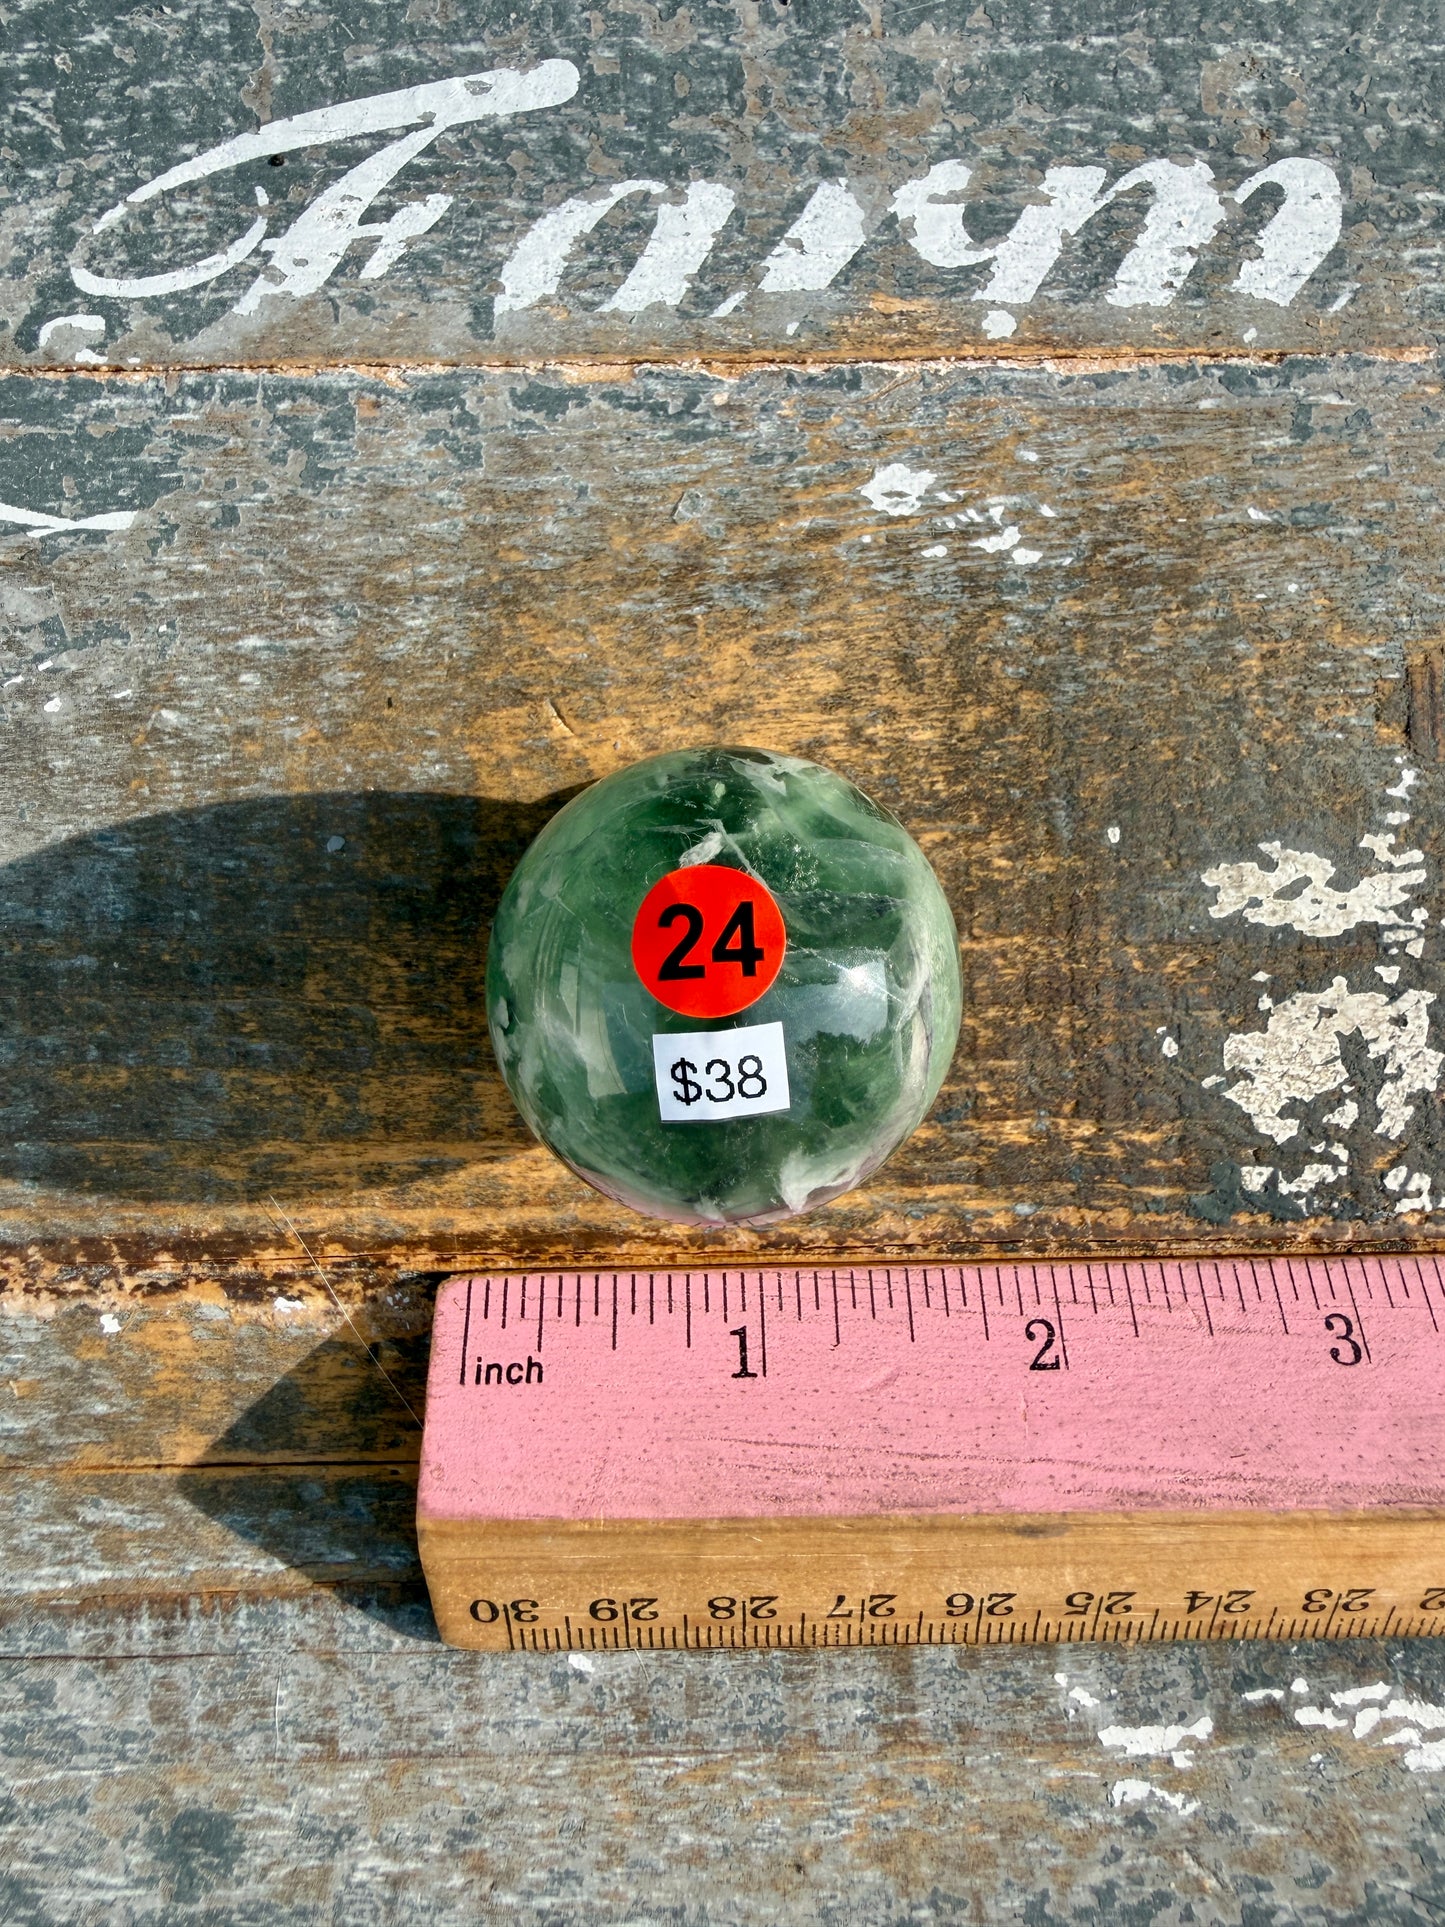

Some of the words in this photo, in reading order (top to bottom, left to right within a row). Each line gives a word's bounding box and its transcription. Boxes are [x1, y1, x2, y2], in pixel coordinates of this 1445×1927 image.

[657, 901, 765, 981] 24
[670, 1055, 767, 1106] $38
[475, 1355, 543, 1385] inch
[729, 1325, 759, 1379] 1
[1025, 1319, 1061, 1371] 2
[1325, 1313, 1363, 1366] 3
[469, 1599, 540, 1624] 30
[589, 1597, 659, 1622] 29
[707, 1595, 779, 1620] 28
[826, 1593, 898, 1620] 27
[945, 1591, 1017, 1617] 26
[1065, 1590, 1137, 1615] 25
[1184, 1589, 1257, 1614] 24
[1301, 1588, 1376, 1613] 23
